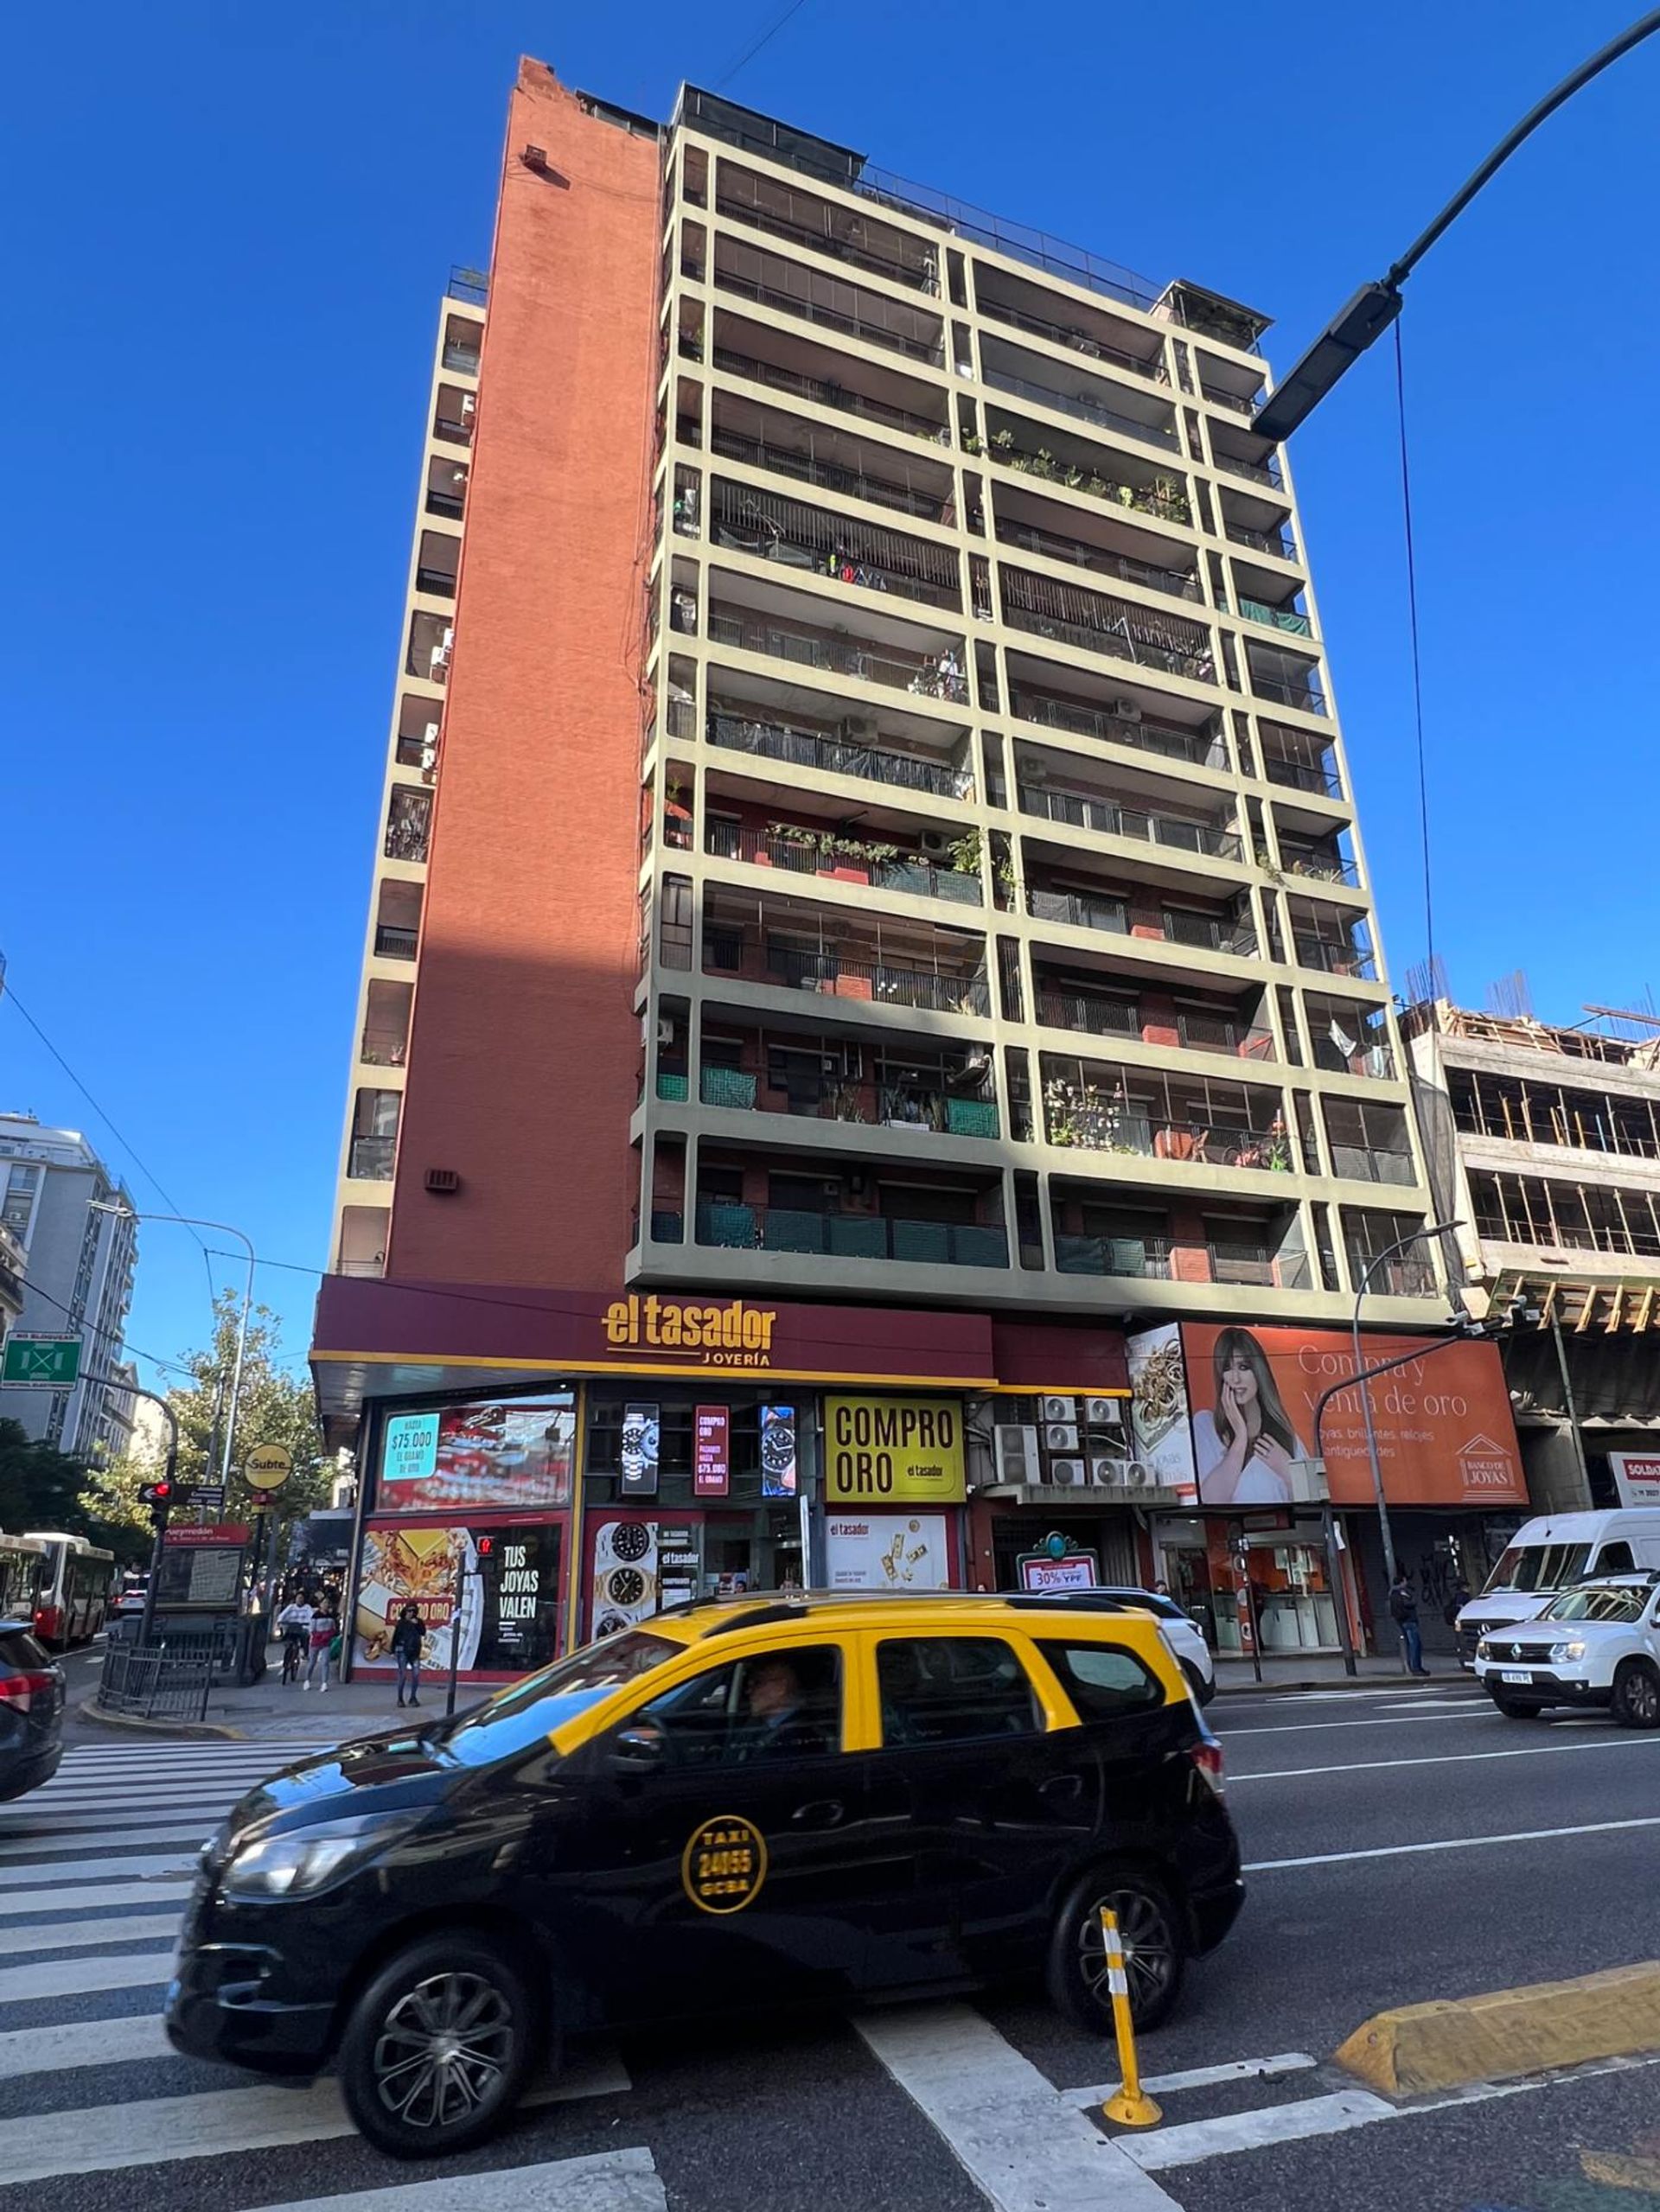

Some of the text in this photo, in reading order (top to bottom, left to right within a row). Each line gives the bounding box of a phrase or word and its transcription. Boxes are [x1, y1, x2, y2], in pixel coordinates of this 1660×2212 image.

[602, 1294, 776, 1350] el tasador
[702, 1352, 769, 1366] JOYERÍA
[1384, 1385, 1416, 1415] de
[1423, 1393, 1467, 1417] oro
[835, 1406, 954, 1449] COMPRO
[251, 1457, 286, 1469] Subte
[916, 1464, 943, 1477] tasador
[836, 1451, 893, 1494] ORO
[1471, 1470, 1508, 1484] JOYAS
[840, 1522, 869, 1536] tasador
[504, 1546, 527, 1568] TUS
[500, 1570, 539, 1593] JOYAS
[1037, 1571, 1061, 1585] 30%
[499, 1597, 537, 1619] VALEN
[702, 1830, 750, 1845] TAXI
